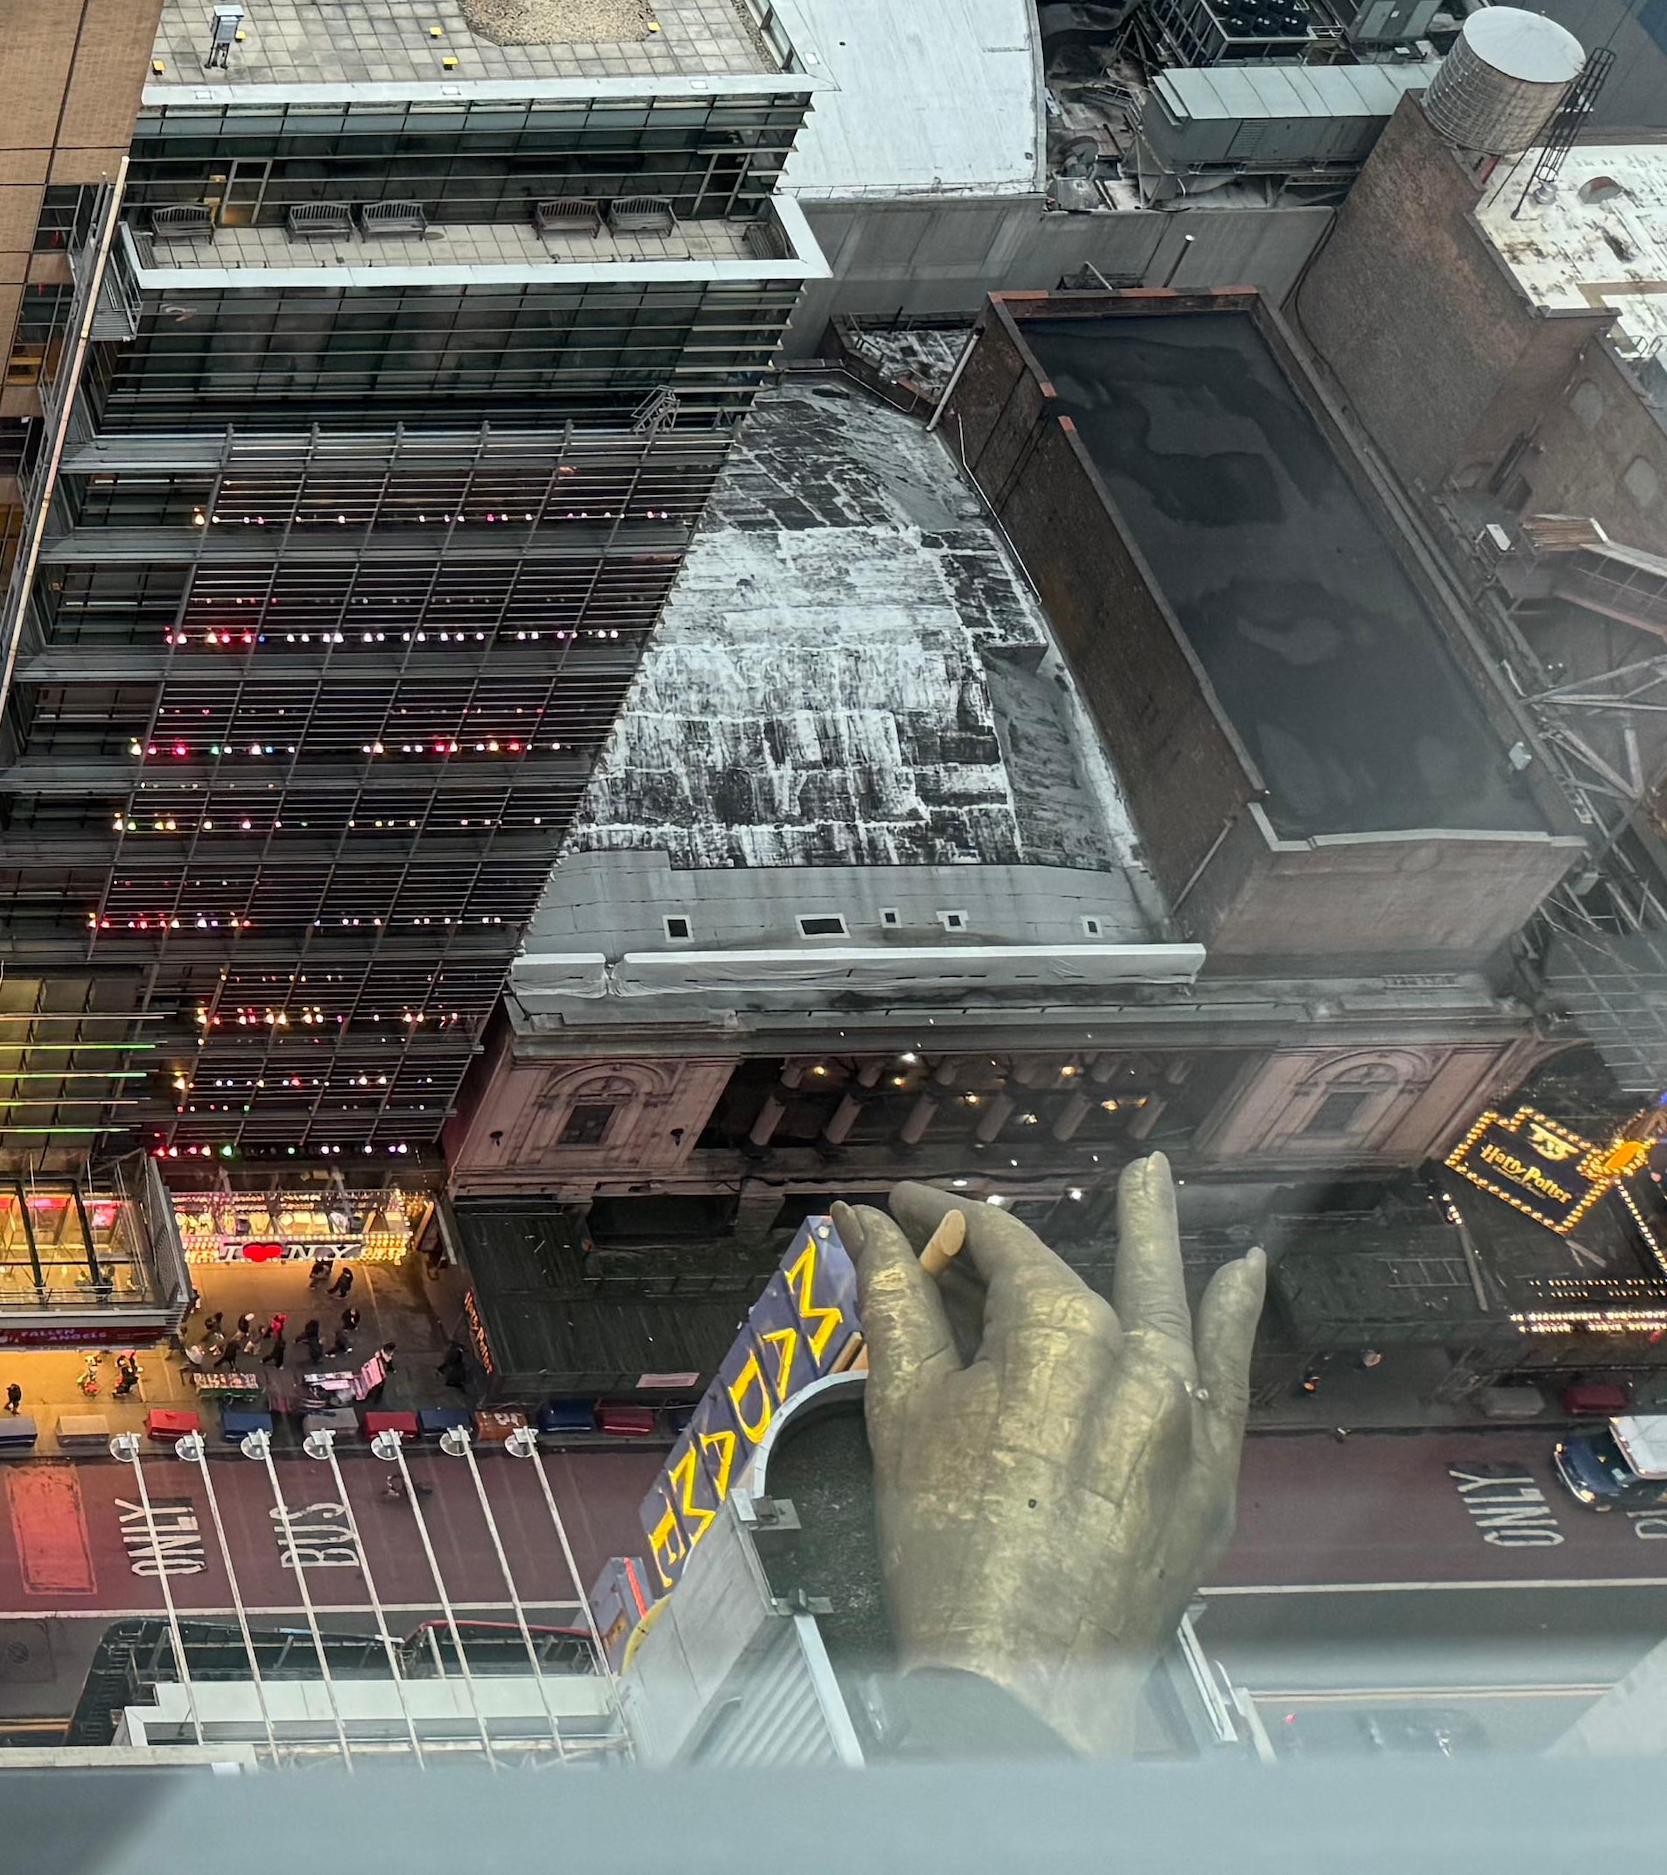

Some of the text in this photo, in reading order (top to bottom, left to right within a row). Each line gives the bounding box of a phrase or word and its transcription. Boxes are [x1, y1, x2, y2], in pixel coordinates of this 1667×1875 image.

[1479, 1143, 1527, 1175] Harry
[1522, 1166, 1573, 1204] Potter
[286, 1244, 361, 1261] NY
[20, 1328, 76, 1338] FALLEN
[47, 1332, 108, 1342] ANGELS
[647, 1234, 844, 1588] MADAME
[114, 1498, 208, 1576] ONLY
[269, 1503, 360, 1568] BUS
[1448, 1470, 1565, 1546] ONLY
